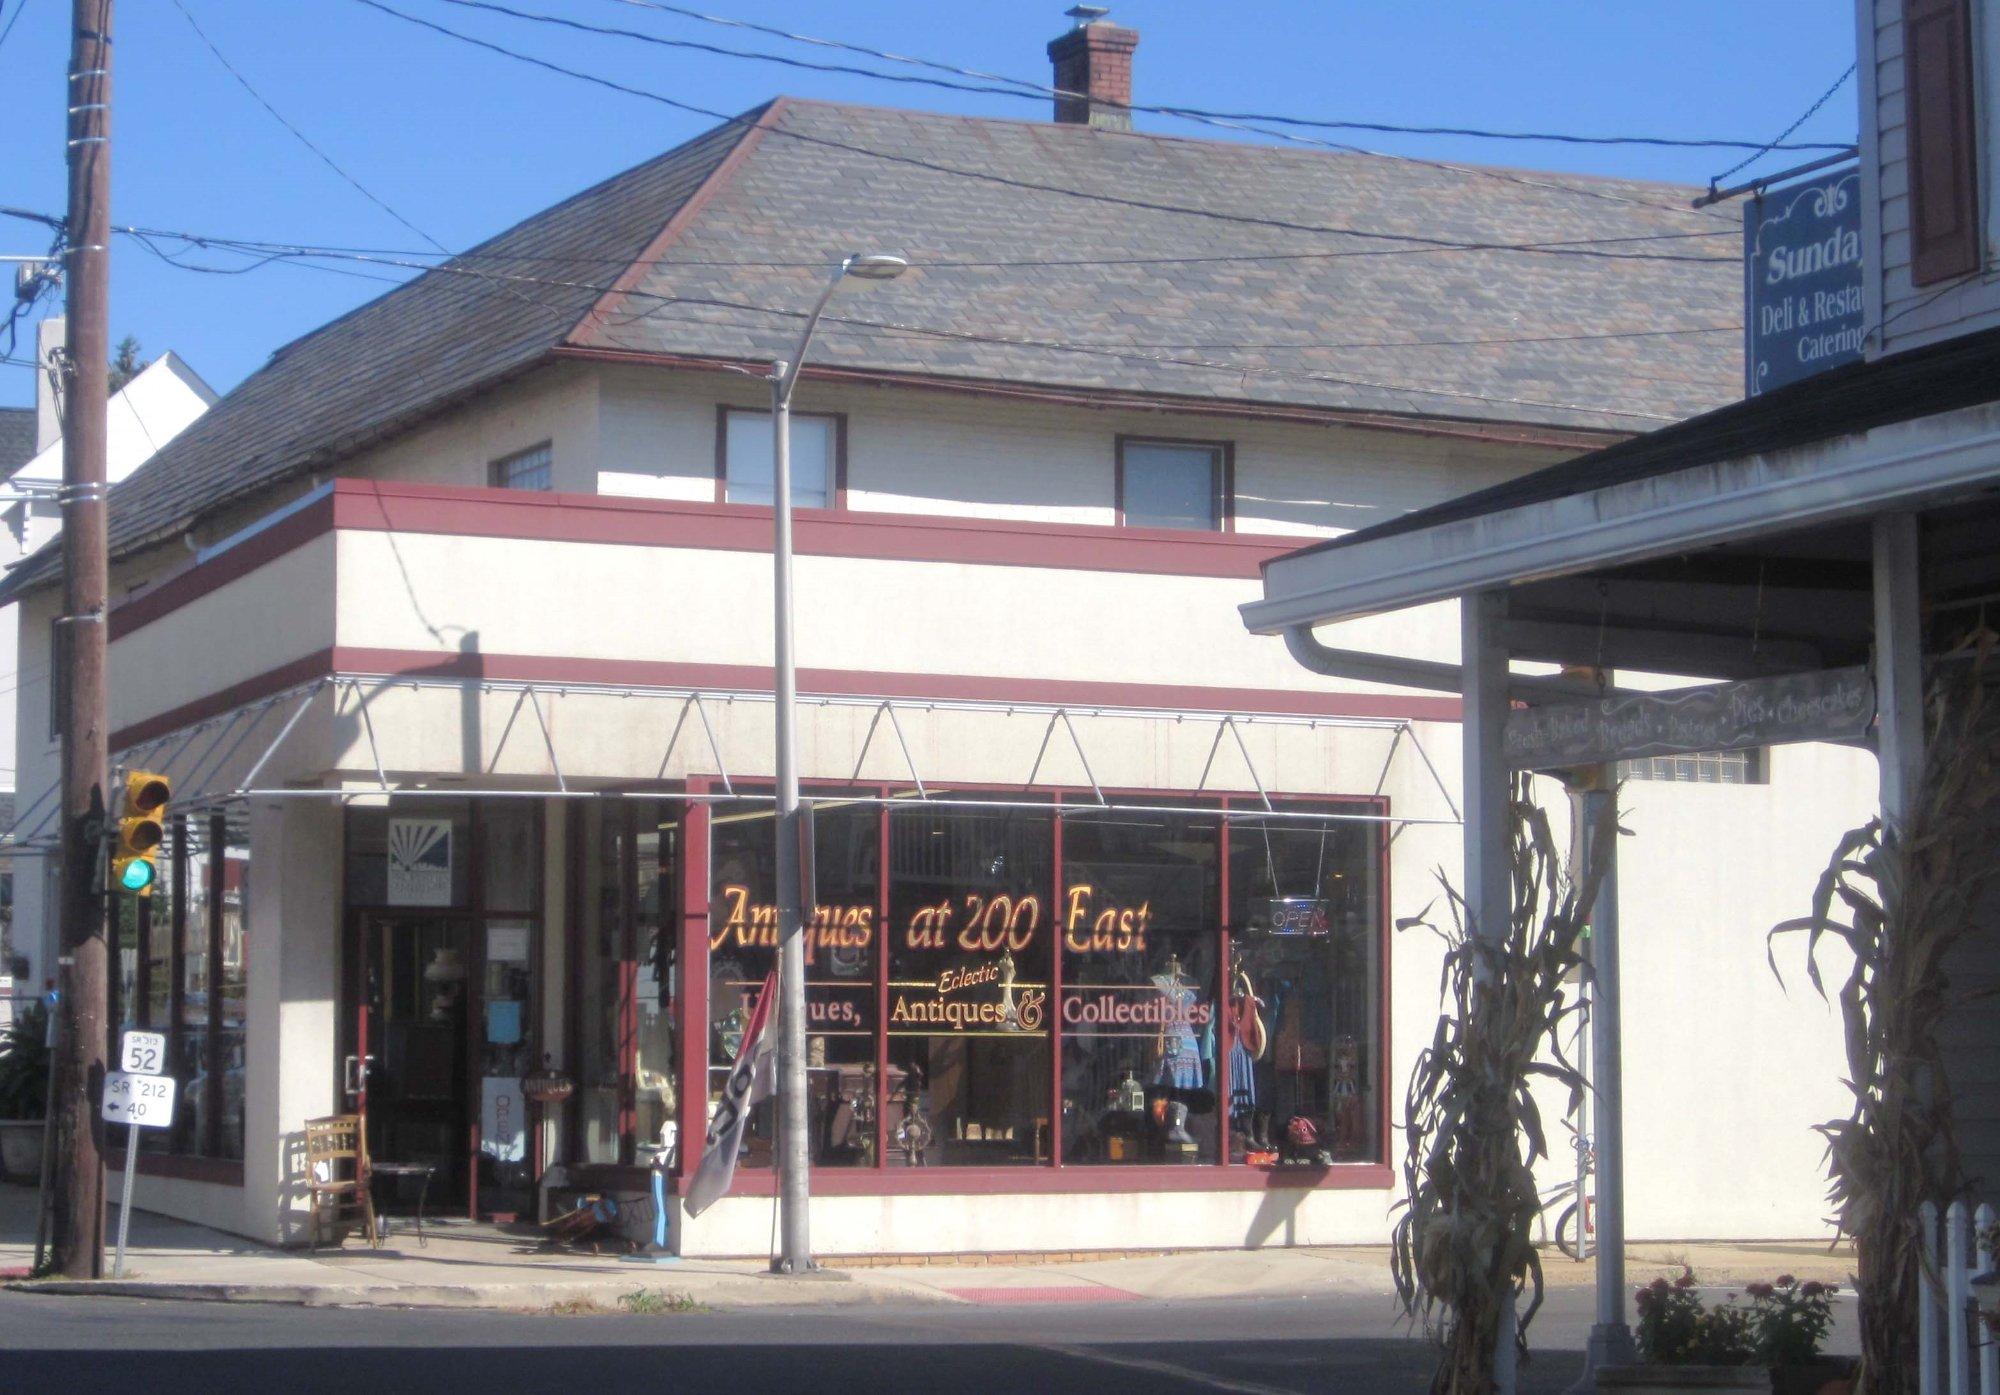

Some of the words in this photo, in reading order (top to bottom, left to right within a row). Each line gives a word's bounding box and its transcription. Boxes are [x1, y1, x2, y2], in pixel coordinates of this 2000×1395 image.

[1766, 226, 1864, 285] Sunda
[1761, 297, 1793, 336] Deli
[1798, 297, 1810, 327] &
[1814, 284, 1864, 323] Resta
[1798, 324, 1866, 362] Catering
[906, 900, 952, 950] at
[958, 894, 1040, 951] 200
[1065, 883, 1151, 954] East
[1272, 910, 1325, 929] OPEN
[937, 960, 1000, 993] Eclectic
[891, 996, 1007, 1030] Antiques
[1015, 989, 1046, 1031] &
[1062, 996, 1210, 1026] Collectibles
[130, 1047, 157, 1071] 52
[111, 1080, 131, 1094] SR
[141, 1082, 168, 1098] 212
[126, 1102, 148, 1117] 40
